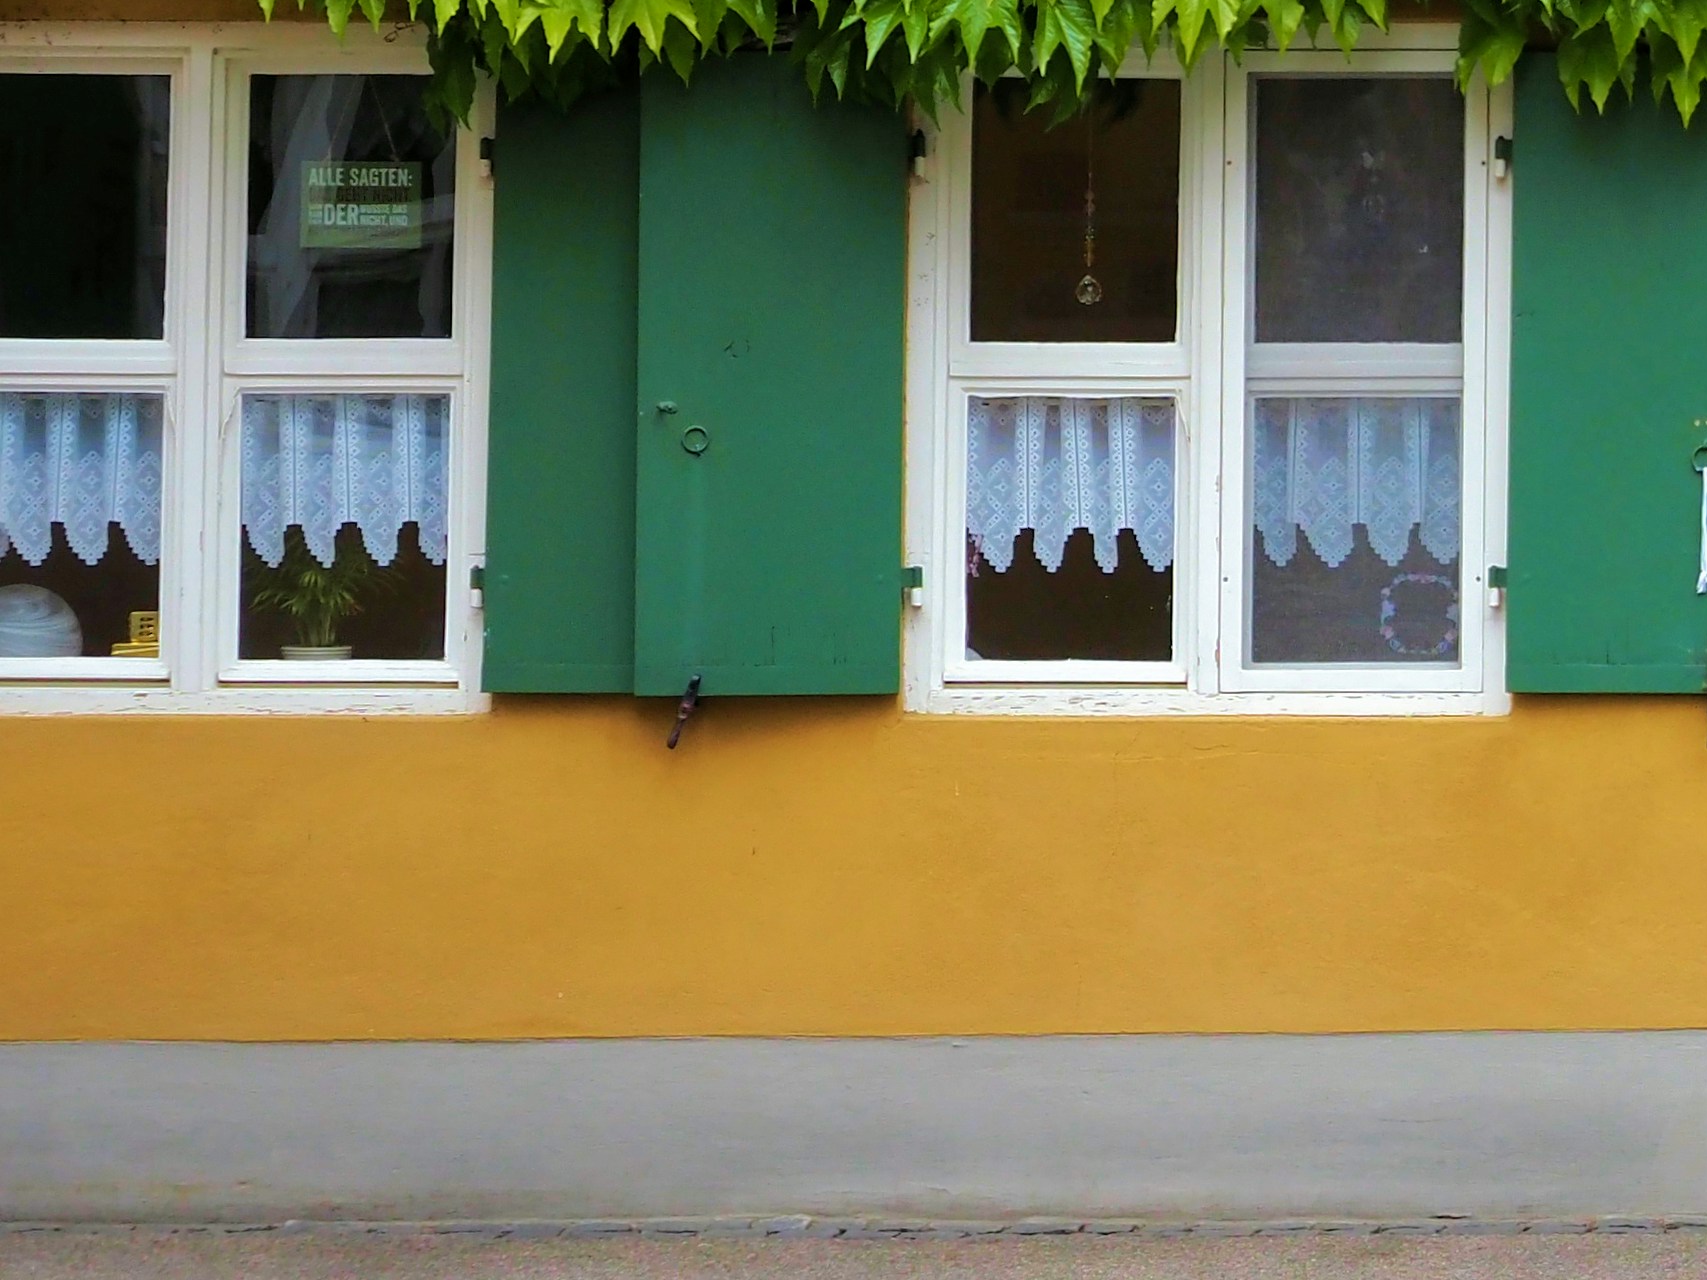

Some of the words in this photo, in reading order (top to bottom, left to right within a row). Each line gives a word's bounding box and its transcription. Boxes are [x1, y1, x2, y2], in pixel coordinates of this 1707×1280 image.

[309, 168, 345, 186] ALLE
[349, 168, 413, 187] SAGTEN:
[323, 203, 359, 226] DER
